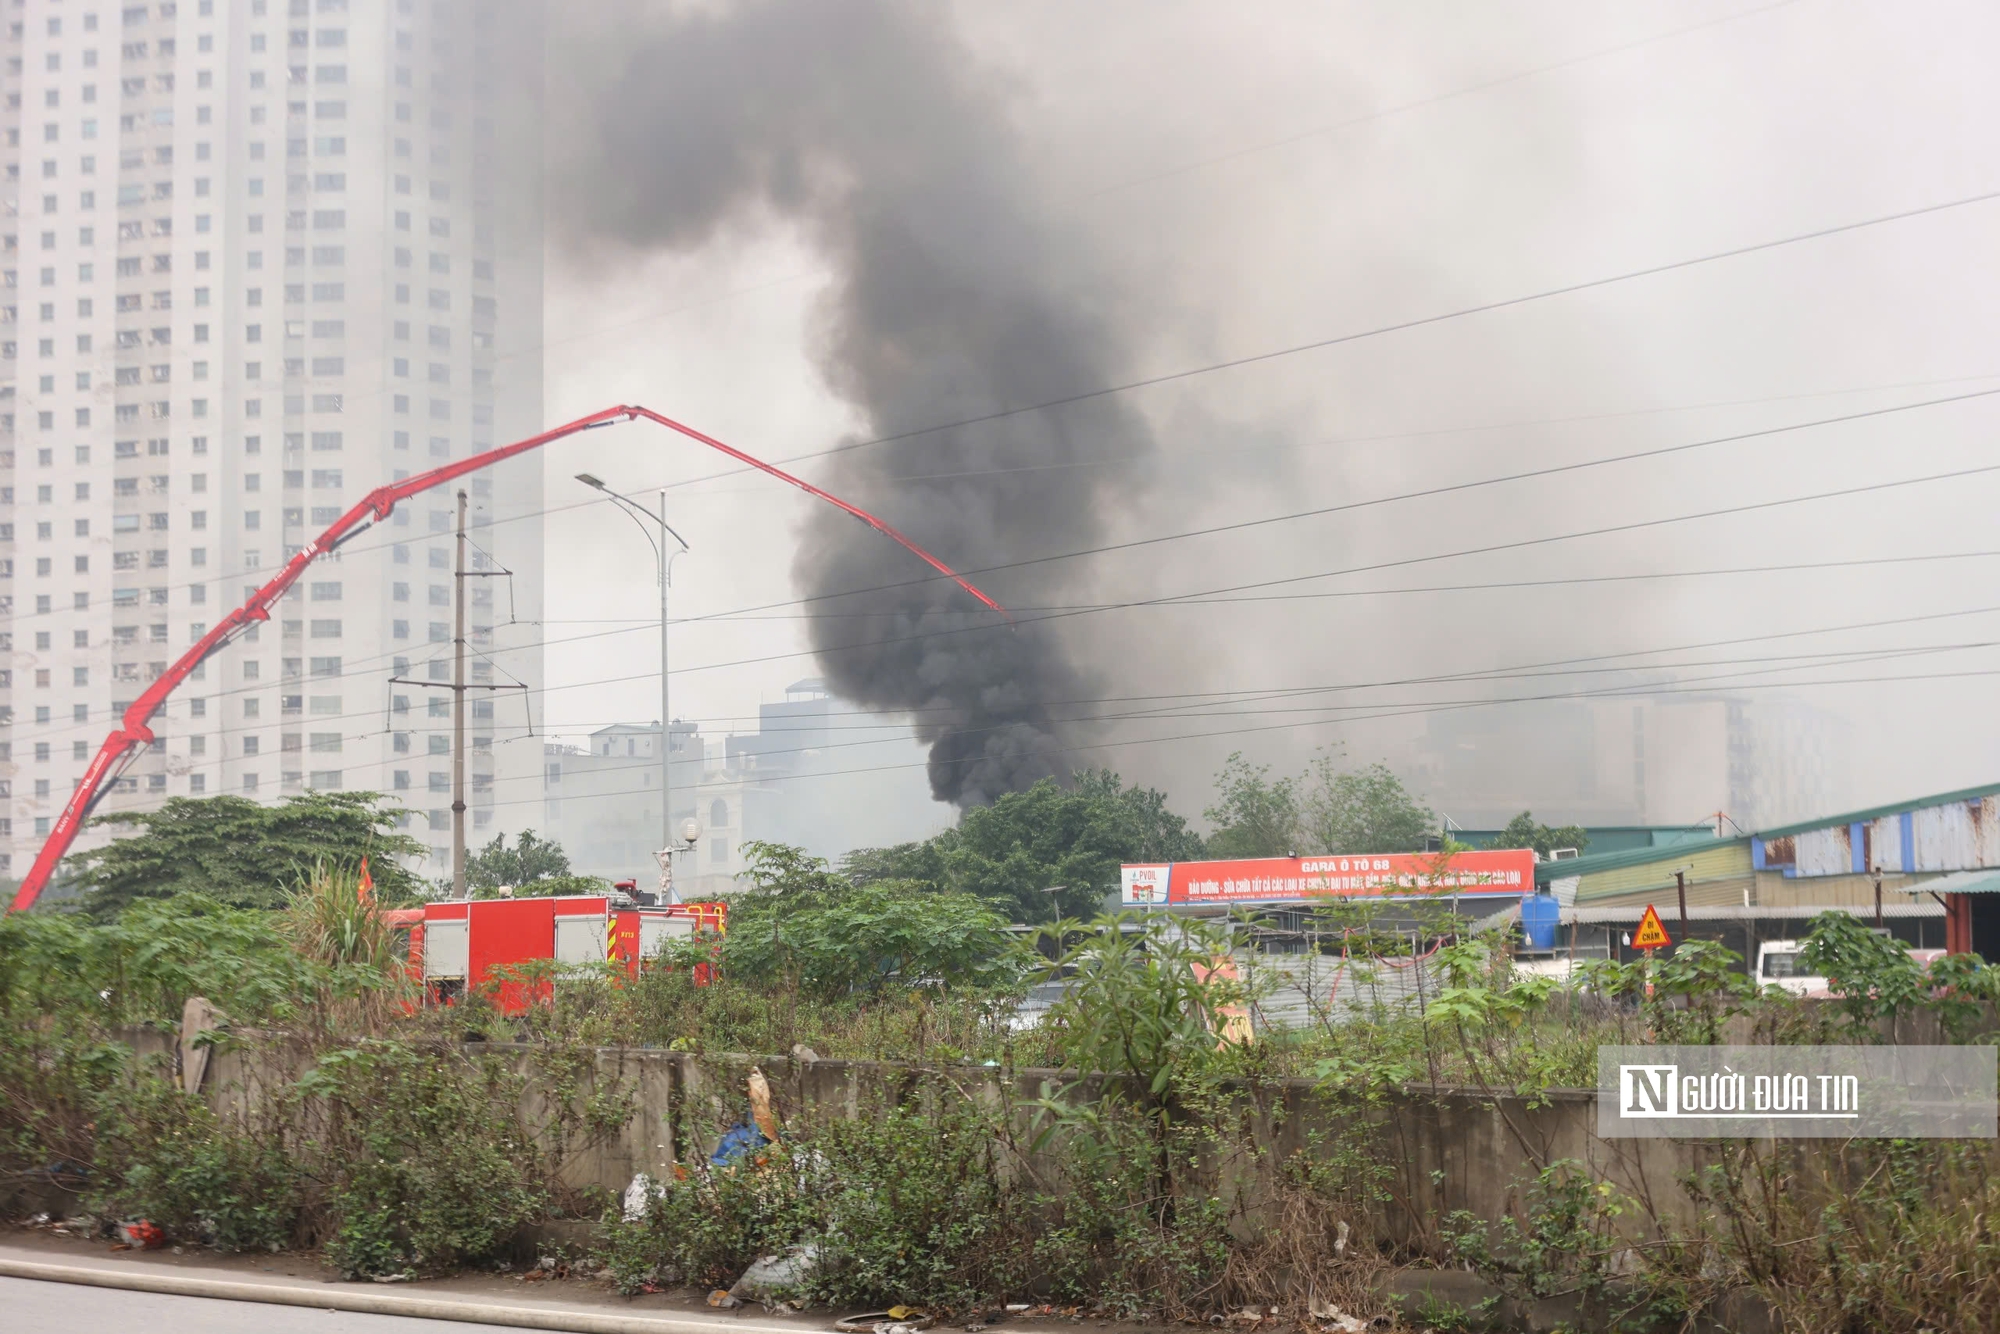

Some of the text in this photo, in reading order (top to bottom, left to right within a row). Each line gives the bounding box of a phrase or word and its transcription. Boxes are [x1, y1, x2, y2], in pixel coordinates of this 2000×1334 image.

[1302, 859, 1390, 872] GARA Ô TÔ 68
[1140, 870, 1157, 880] PVOIL
[1252, 876, 1262, 892] TẤT
[1263, 876, 1271, 892] CẢ
[1272, 877, 1283, 891] CÁC
[1284, 878, 1297, 893] LOẠI
[1299, 877, 1306, 890] XE
[1506, 870, 1521, 887] LOẠI
